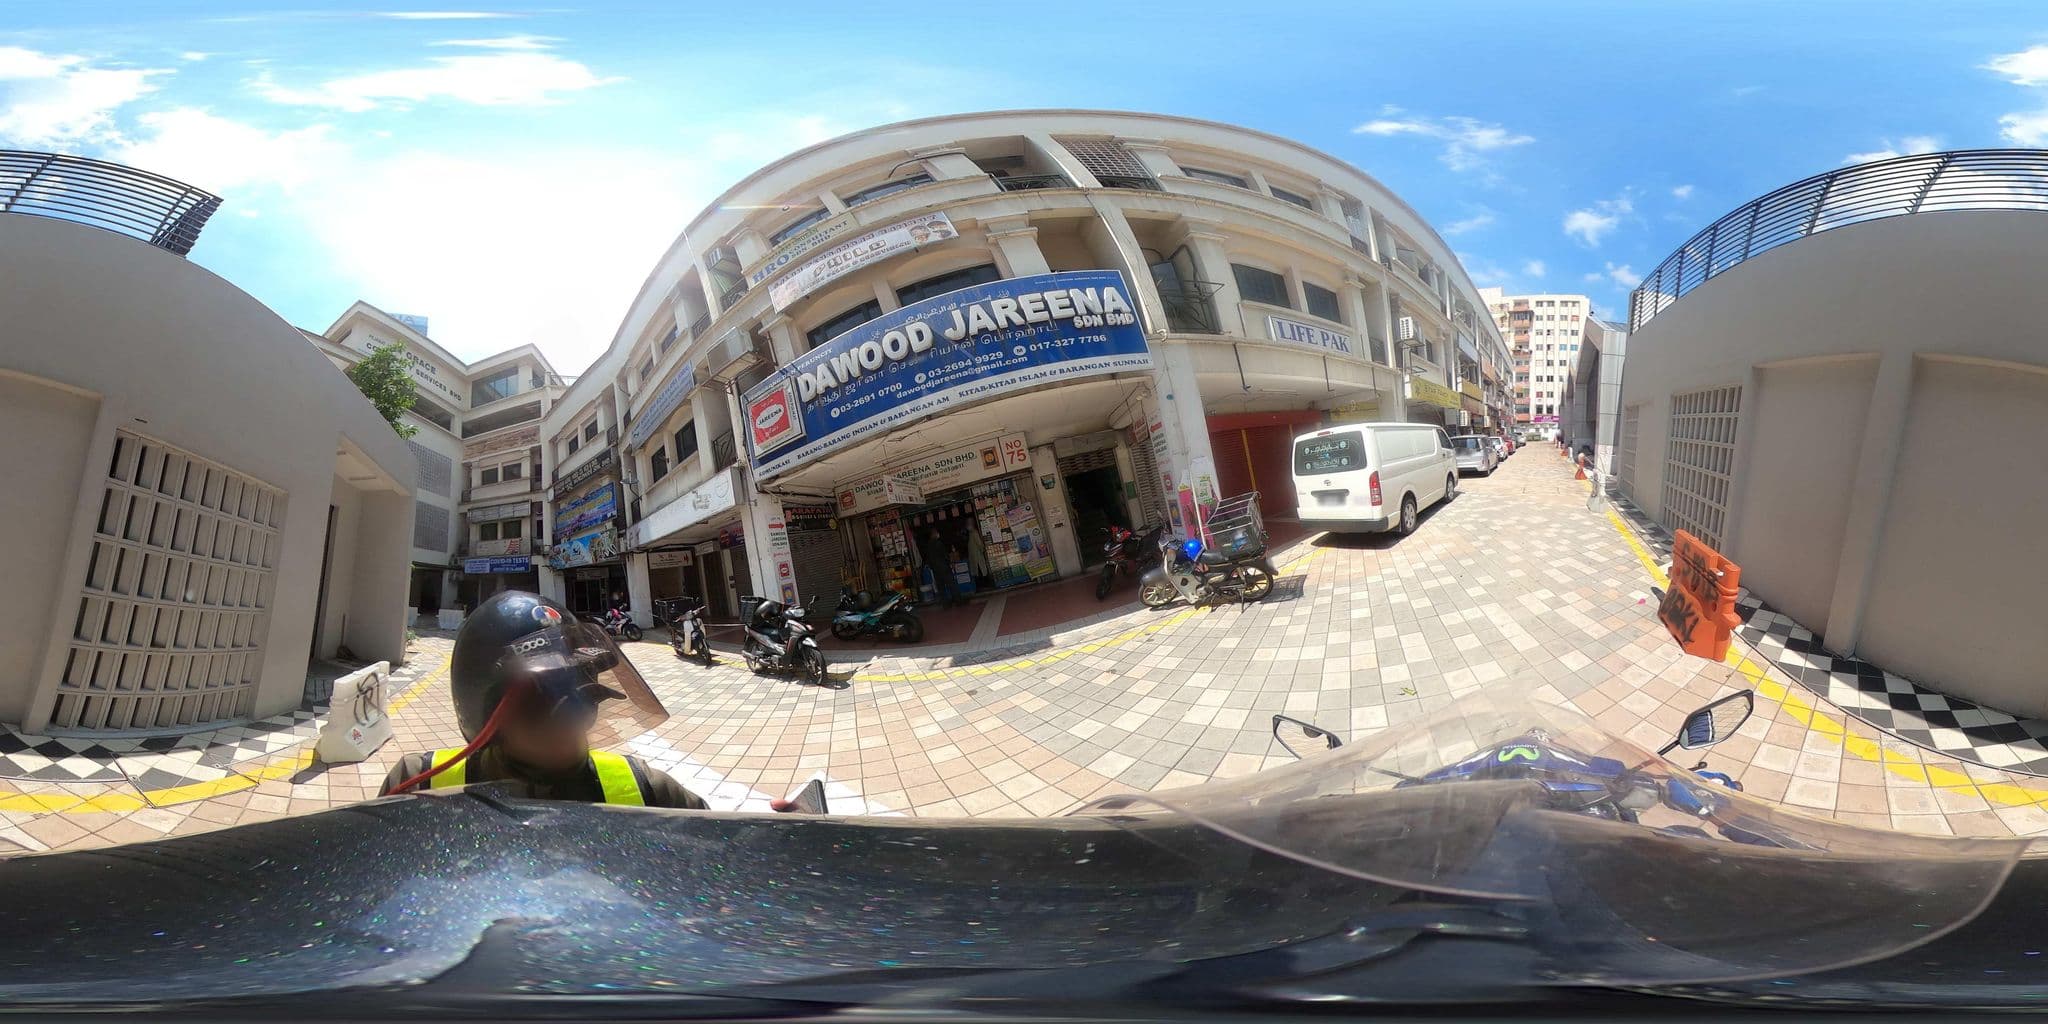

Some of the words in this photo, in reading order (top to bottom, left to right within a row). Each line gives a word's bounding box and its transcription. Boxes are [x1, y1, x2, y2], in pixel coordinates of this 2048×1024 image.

[789, 219, 848, 255] CONSULTANT
[1073, 314, 1104, 329] SDN
[1105, 312, 1135, 326] BHD
[796, 321, 933, 403] DAWOOD
[944, 286, 1132, 341] JAREENA
[1029, 337, 1076, 351] 017-327
[1078, 334, 1107, 344] 7786
[1276, 319, 1319, 345] LIFE
[1320, 331, 1351, 354] PAK
[406, 351, 439, 376] GRACE
[896, 355, 1029, 399] dawoodjareena@gmail.com
[928, 359, 973, 378] 03-2694
[975, 351, 1004, 364] 9929
[415, 369, 448, 393] SERVICES
[797, 433, 852, 460] BARANG-BARANG
[852, 420, 880, 440] INDIAN
[888, 400, 936, 423] BARANGAN
[936, 395, 951, 407] AM
[958, 376, 1017, 398] KITAB-KITAB
[1018, 370, 1048, 383] ISLAM
[1058, 361, 1112, 375] BARANGAN
[1112, 358, 1149, 367] SUNNAH
[839, 393, 876, 413] 03-2691
[878, 382, 903, 397] 0700
[757, 407, 783, 426] JAREENA
[1005, 439, 1022, 450] NO
[1006, 449, 1027, 465] 75
[855, 479, 885, 494] DAWOO
[893, 464, 931, 481] AREENA
[934, 458, 953, 470] SDN
